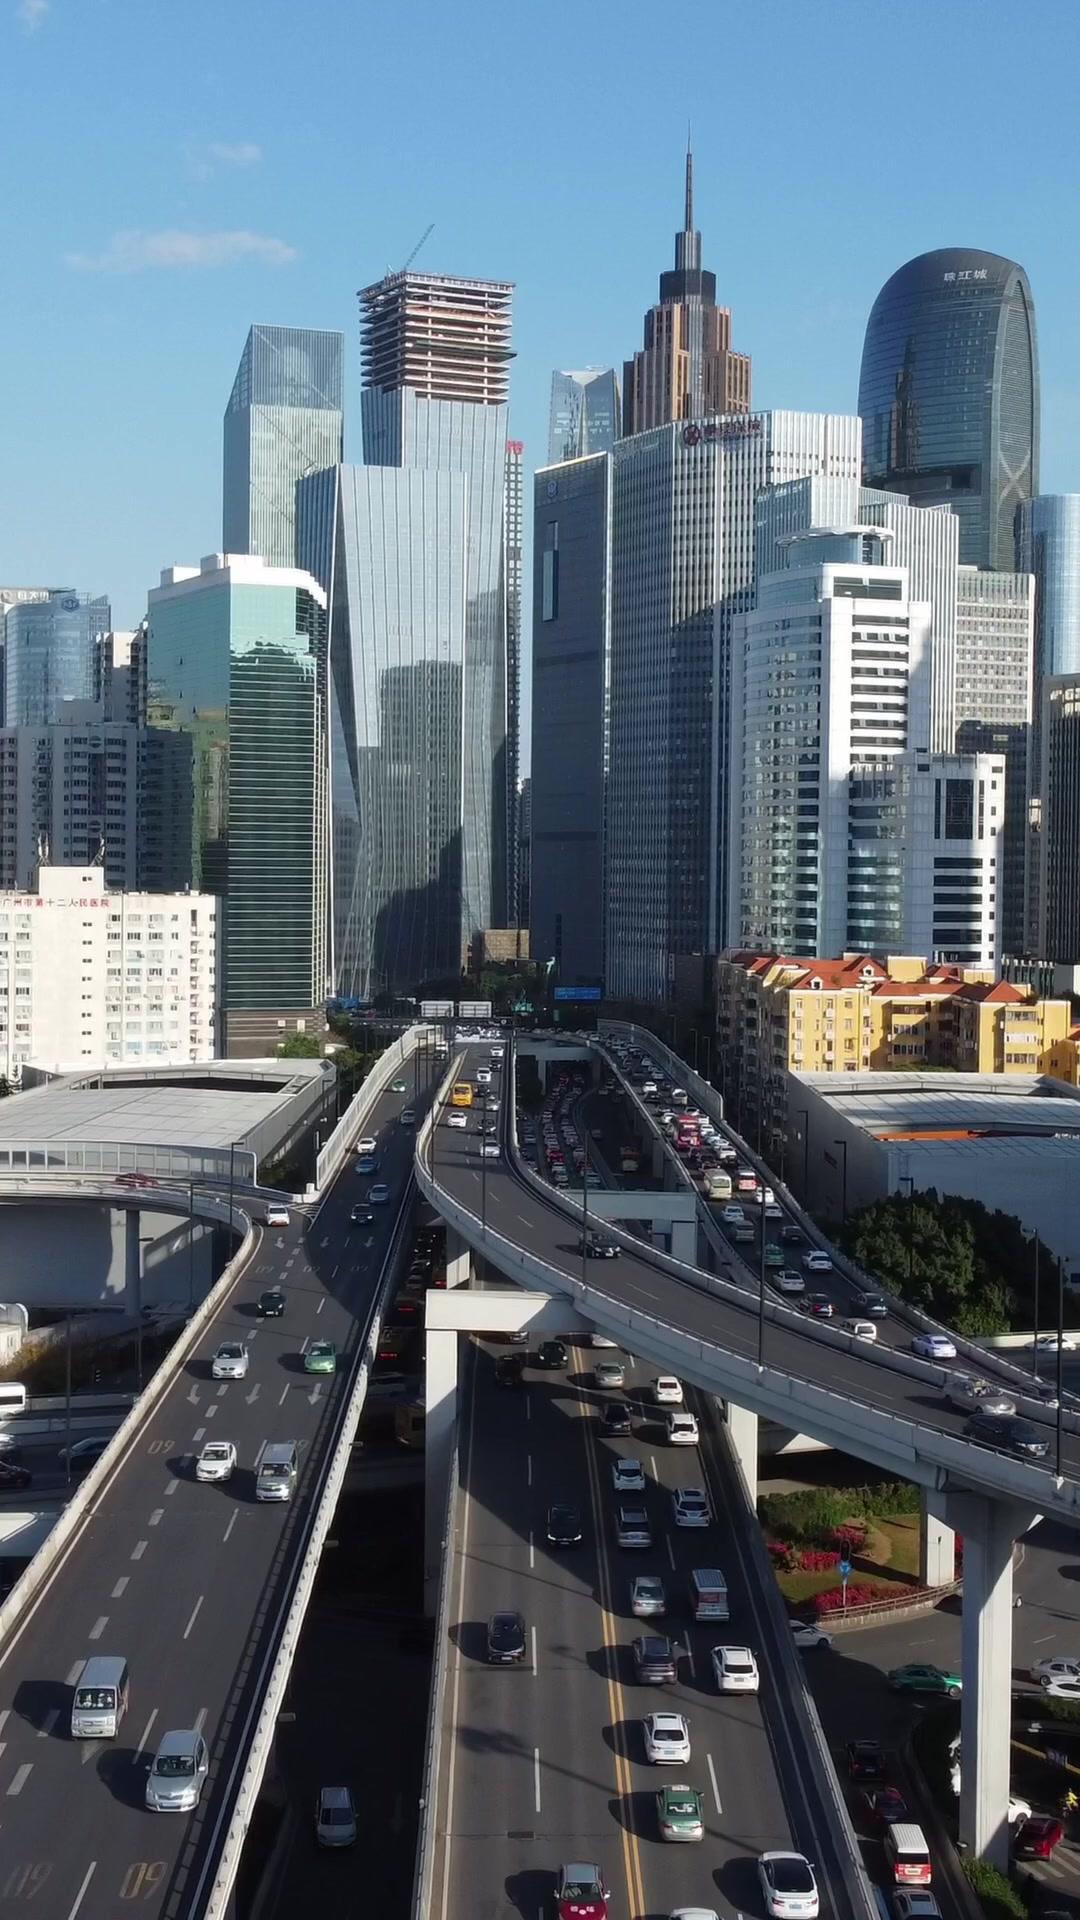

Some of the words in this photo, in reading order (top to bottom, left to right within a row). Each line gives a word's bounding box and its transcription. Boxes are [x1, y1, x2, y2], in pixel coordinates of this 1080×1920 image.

[2, 898, 111, 908] 广州市第十二人民医院
